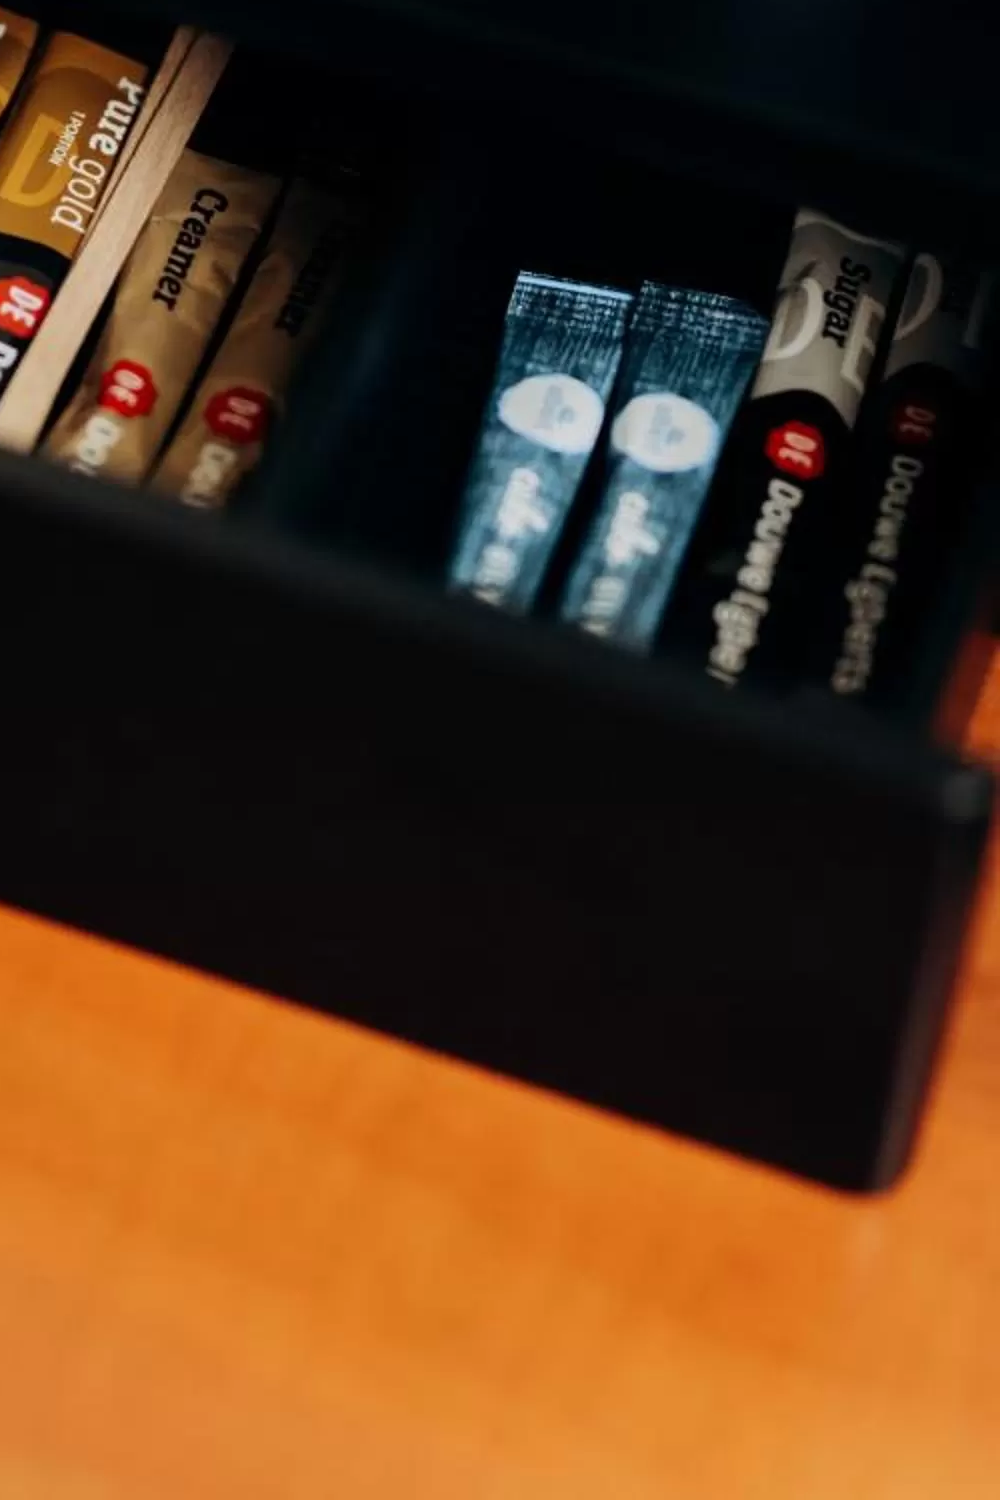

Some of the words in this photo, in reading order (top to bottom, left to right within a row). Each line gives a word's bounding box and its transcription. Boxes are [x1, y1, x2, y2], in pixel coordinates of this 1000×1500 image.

[48, 116, 84, 166] PORTION
[50, 155, 105, 233] gold
[153, 188, 228, 311] Creamer
[822, 257, 871, 348] Sugar
